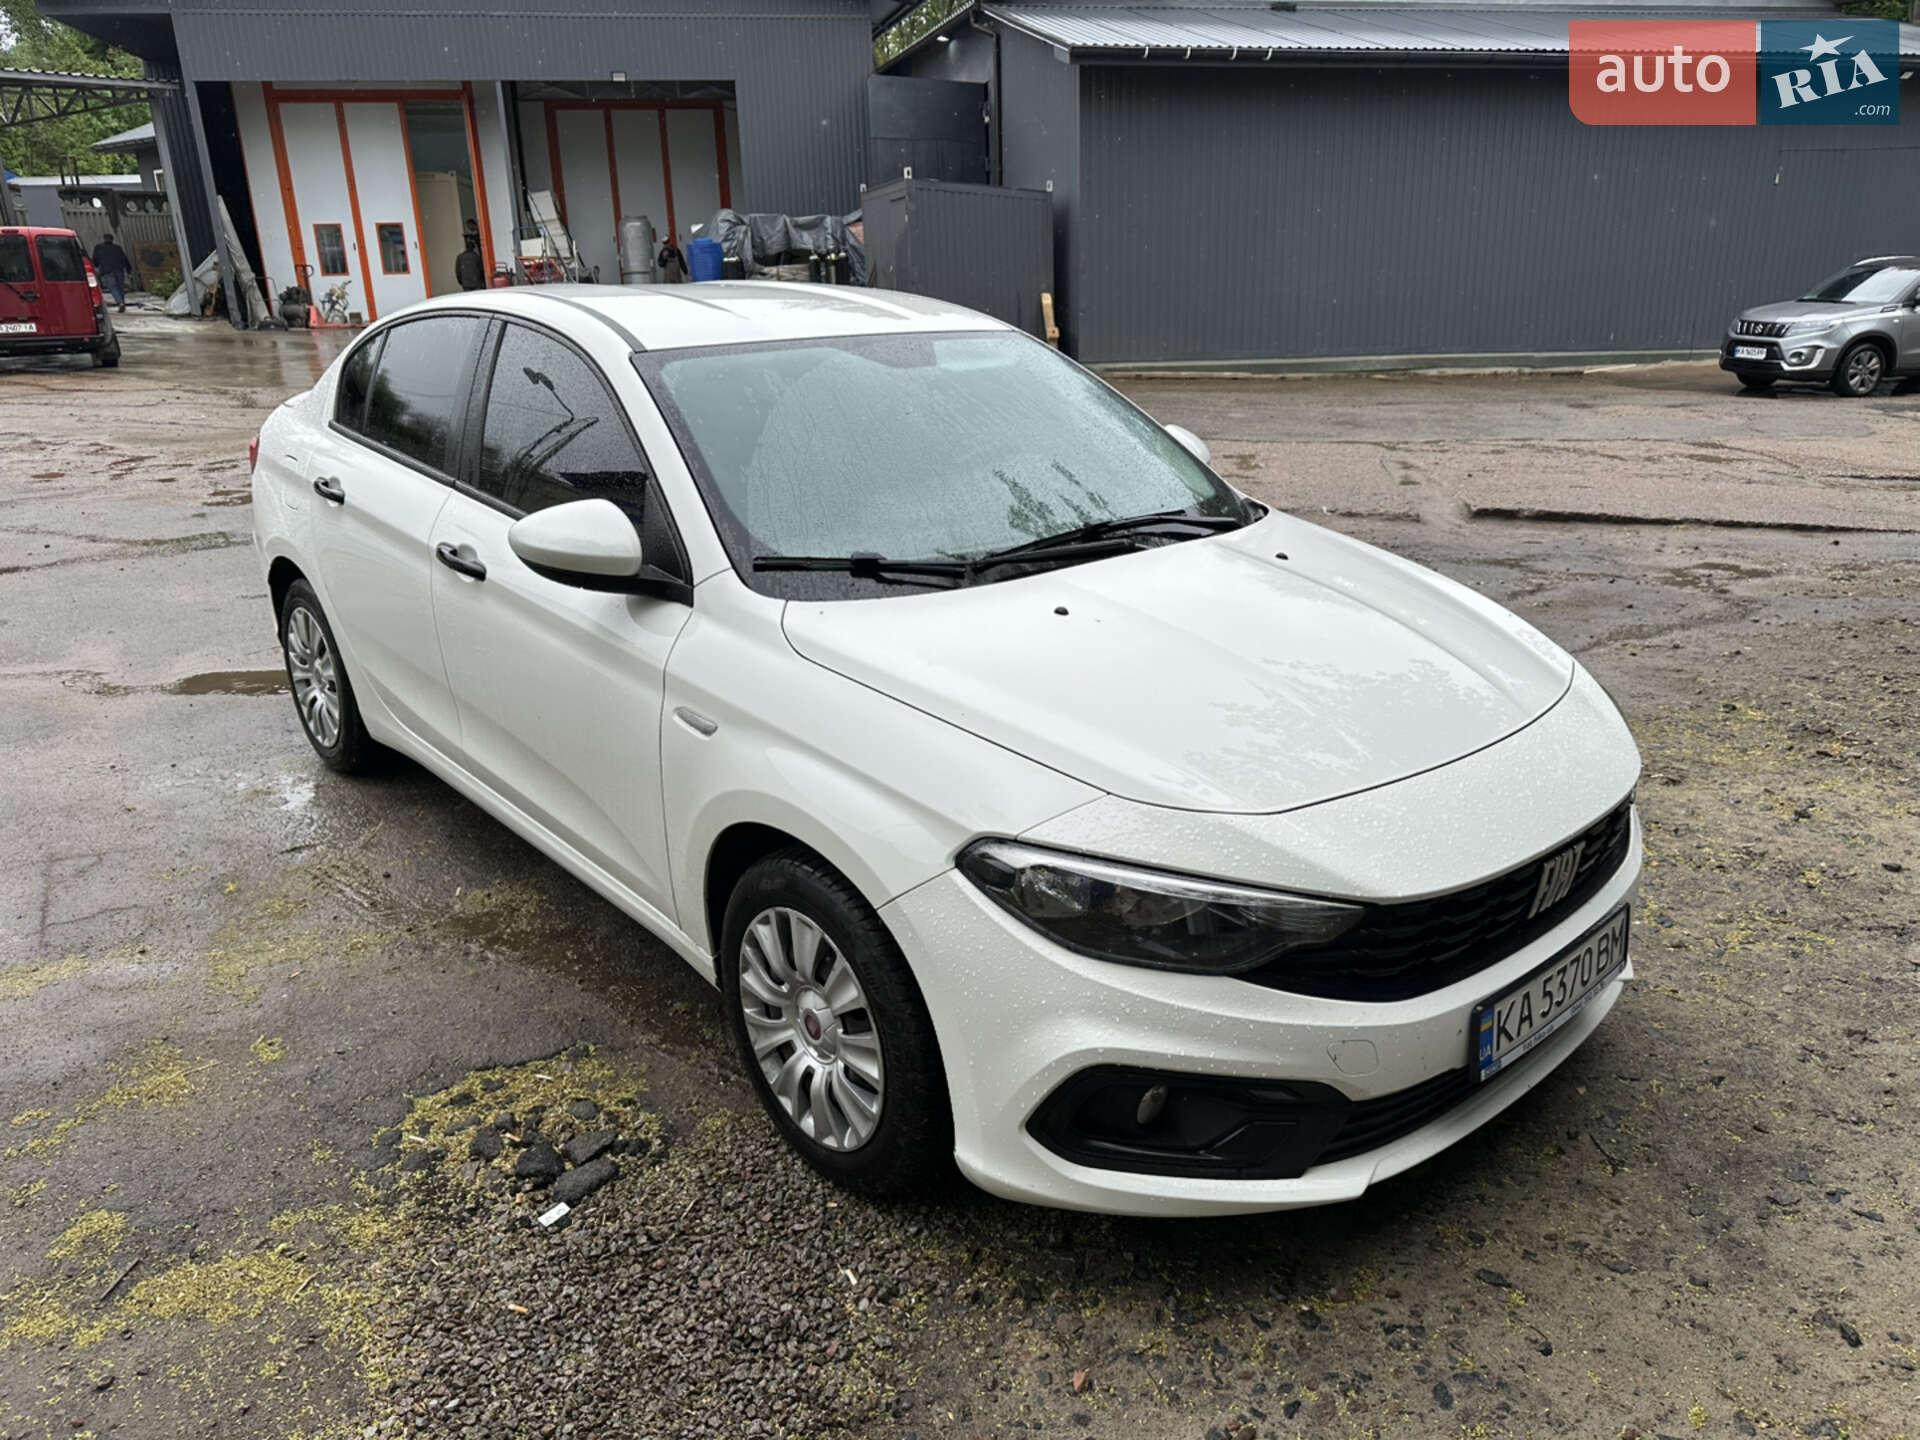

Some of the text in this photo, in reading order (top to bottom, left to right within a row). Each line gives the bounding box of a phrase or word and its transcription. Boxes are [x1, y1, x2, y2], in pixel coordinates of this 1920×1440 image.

[1496, 990, 1534, 1052] KA
[1540, 945, 1594, 1018] 5370
[1596, 917, 1626, 977] BM
